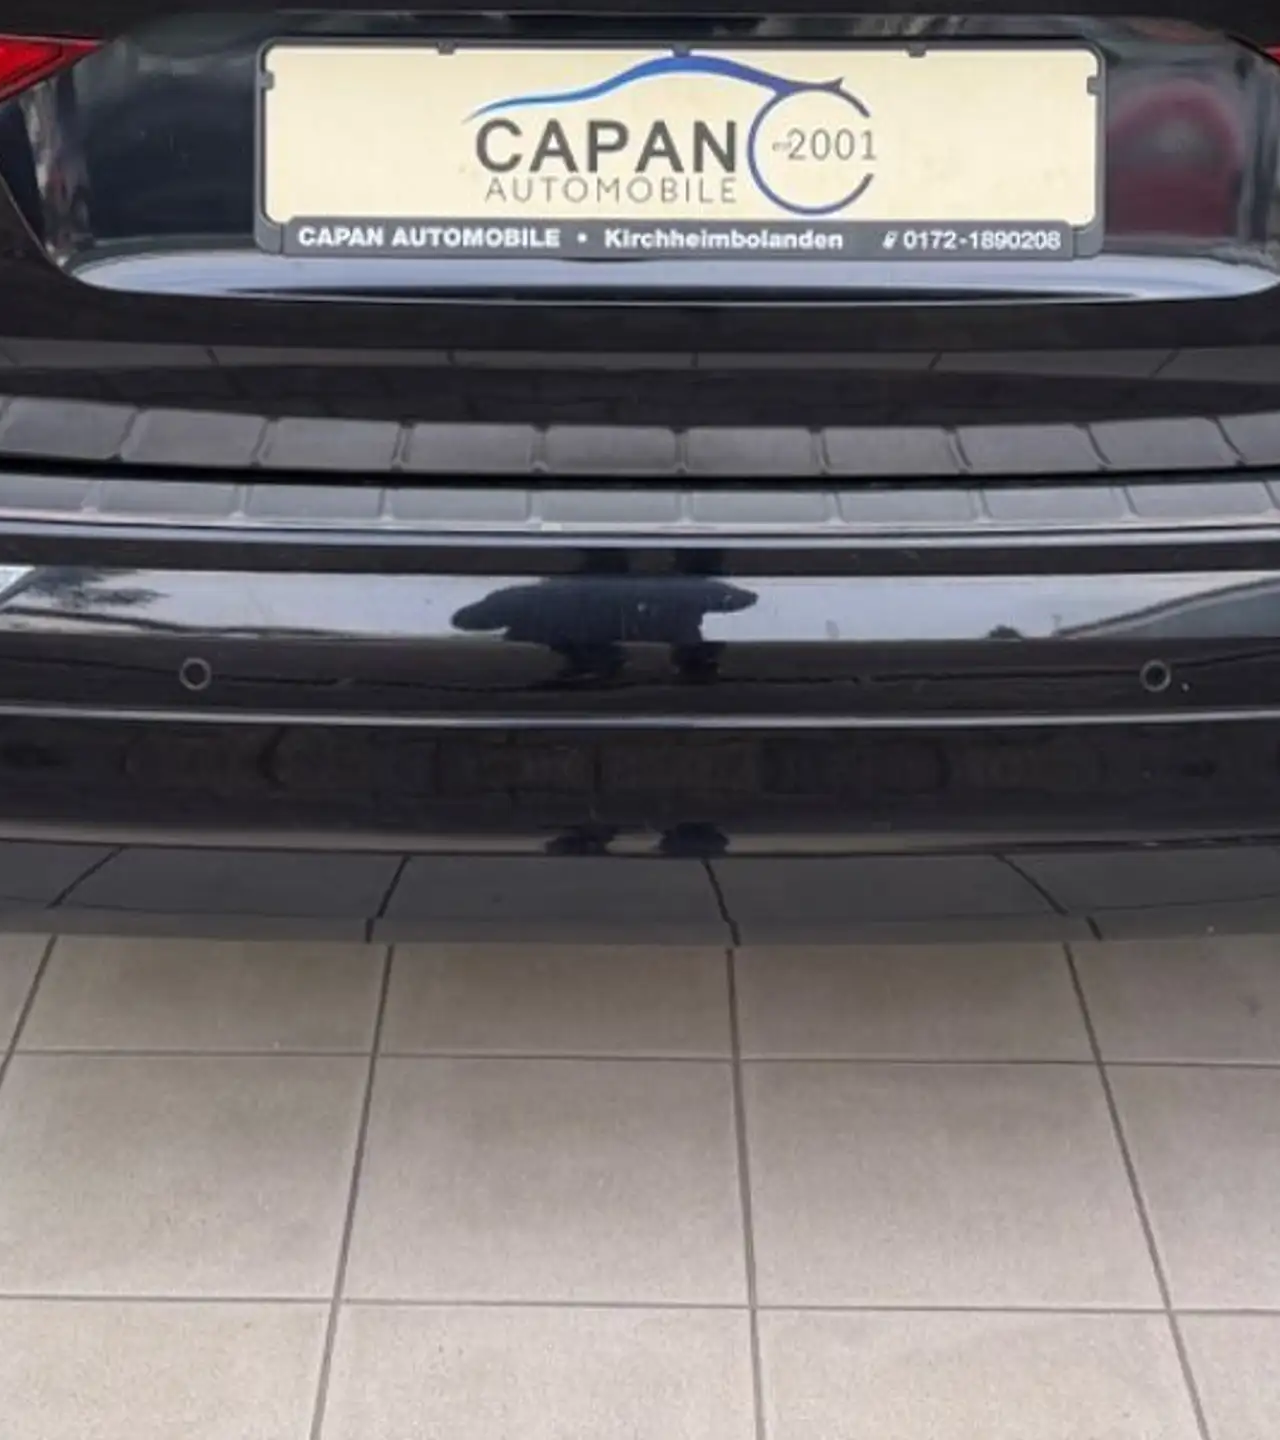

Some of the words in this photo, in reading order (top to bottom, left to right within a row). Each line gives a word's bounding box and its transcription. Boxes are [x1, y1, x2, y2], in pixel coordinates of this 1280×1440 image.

[476, 118, 737, 174] CAPAN
[787, 127, 877, 161] 2001
[484, 176, 738, 204] AUTOMOBILE
[297, 225, 384, 247] CAPAN
[392, 226, 561, 248] AUTOMOBILE
[604, 227, 843, 249] Kirchheimbolanden
[902, 229, 1062, 250] 0172-1890208
